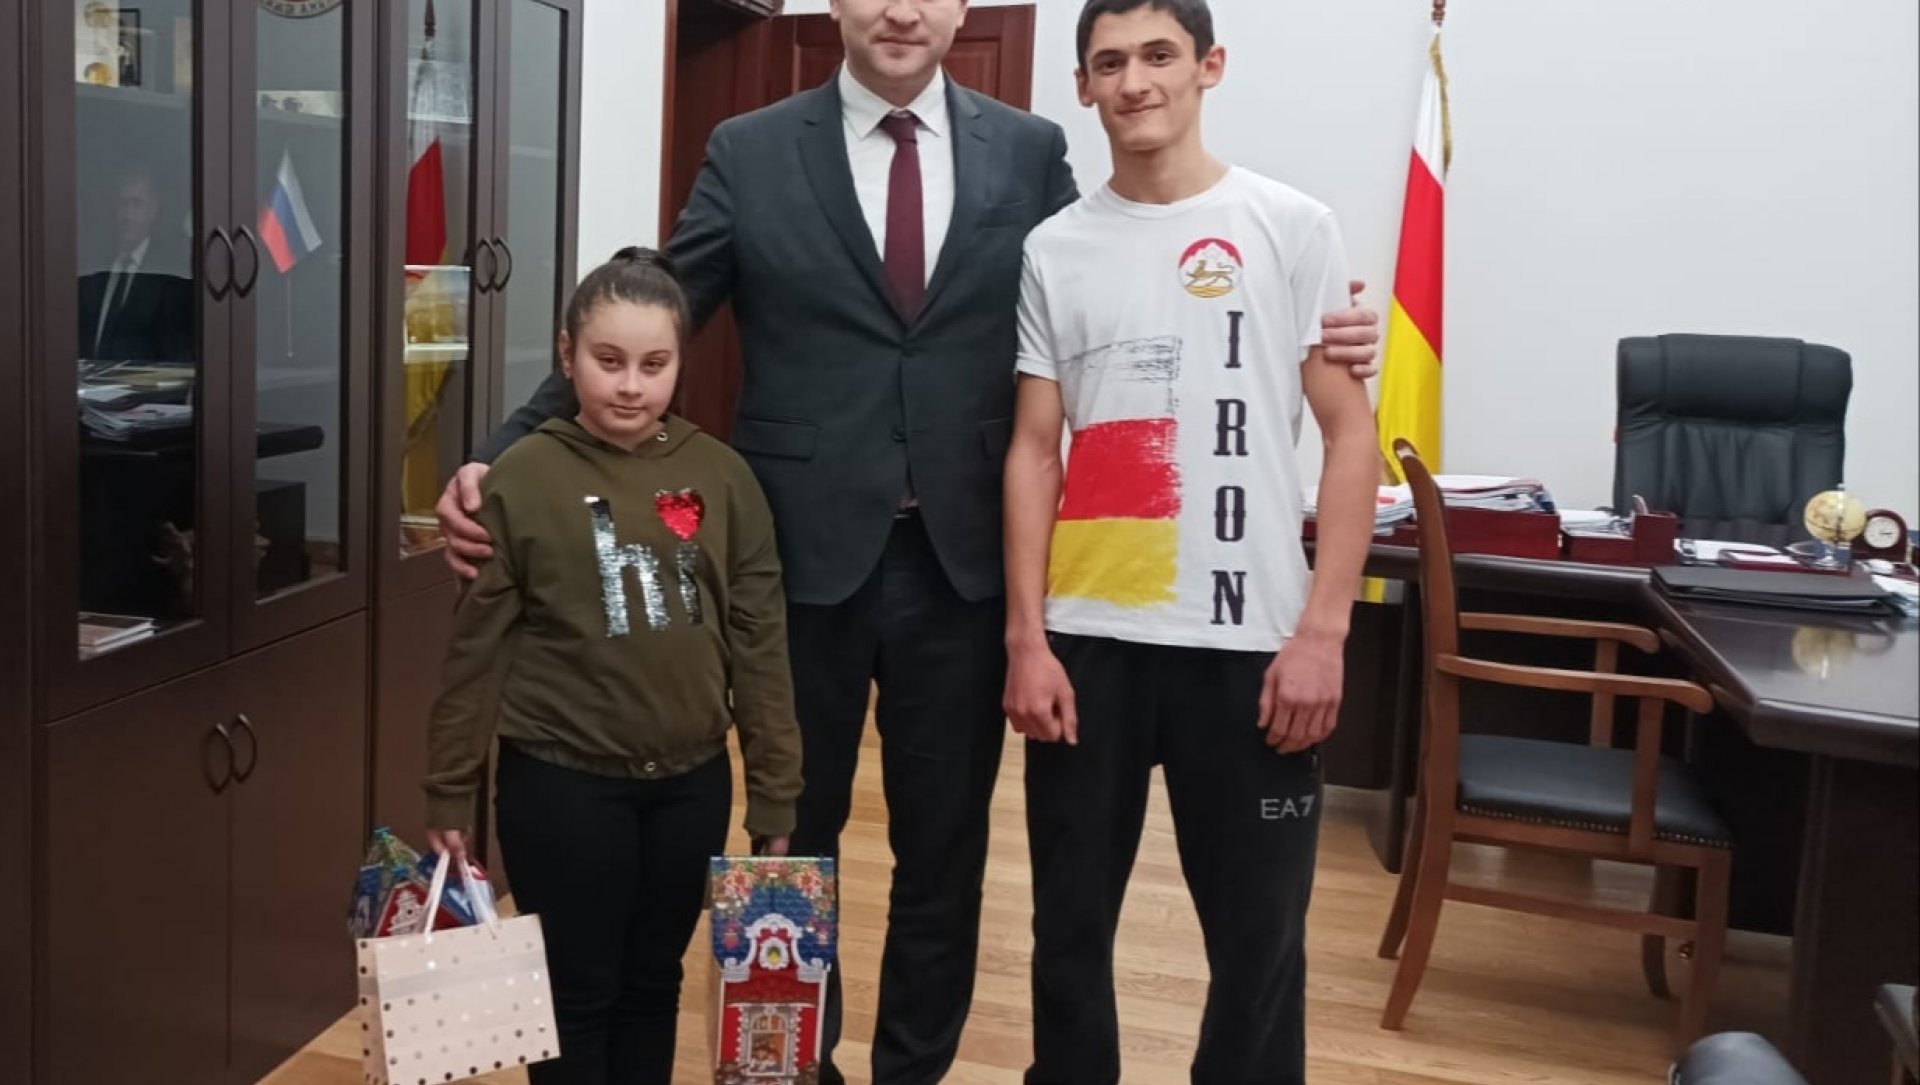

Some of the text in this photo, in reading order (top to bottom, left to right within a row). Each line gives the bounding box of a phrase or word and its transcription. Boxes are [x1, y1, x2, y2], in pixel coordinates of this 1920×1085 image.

[1210, 310, 1249, 625] IRON
[585, 489, 705, 637] hi
[1260, 796, 1315, 819] EA7
